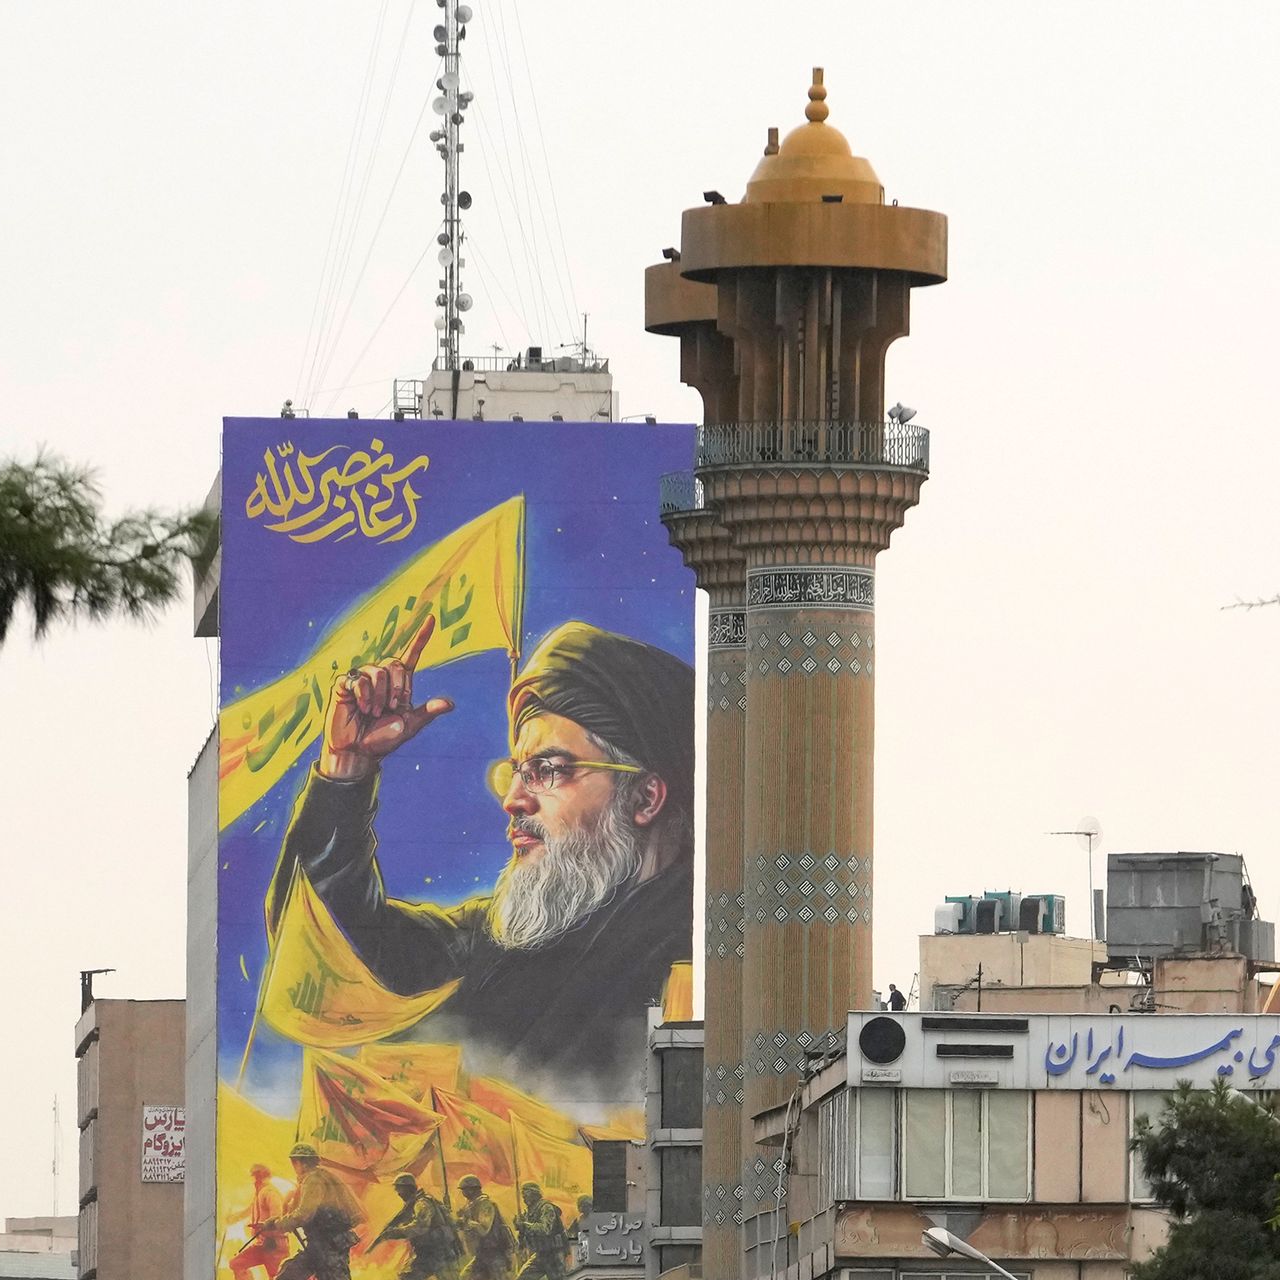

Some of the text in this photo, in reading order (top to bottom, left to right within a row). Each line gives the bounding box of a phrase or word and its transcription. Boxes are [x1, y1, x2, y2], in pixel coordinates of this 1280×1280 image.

[1045, 1024, 1125, 1085] ایران
[1123, 1026, 1244, 1077] بیمه
[144, 1108, 186, 1131] پارس
[144, 1132, 186, 1157] ایزوگام
[595, 1212, 643, 1236] صرافی
[595, 1239, 643, 1263] پارسه
